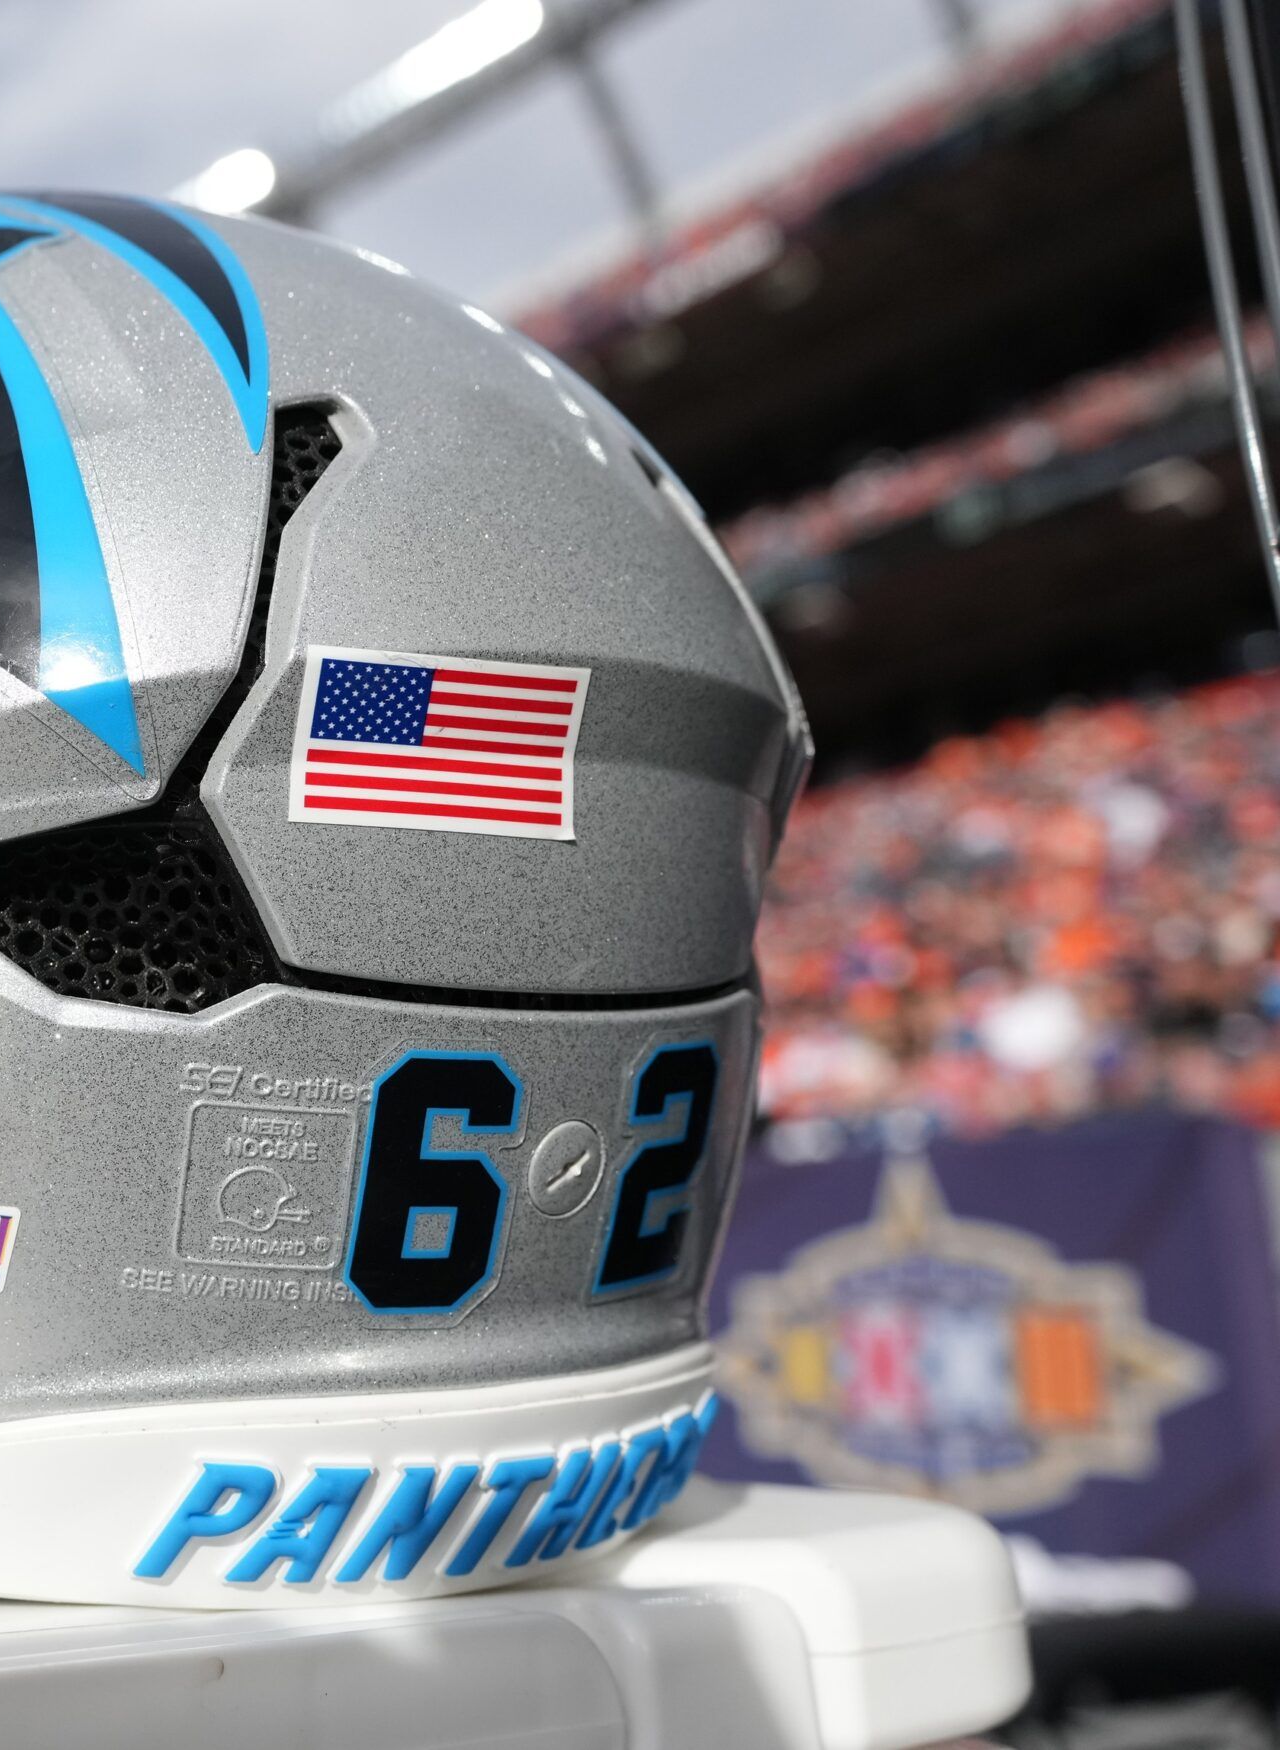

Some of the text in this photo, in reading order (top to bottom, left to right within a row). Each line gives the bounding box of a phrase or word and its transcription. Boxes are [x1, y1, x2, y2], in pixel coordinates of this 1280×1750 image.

[240, 1117, 307, 1138] MEETS
[224, 1136, 320, 1163] NOCSAE
[344, 1040, 720, 1314] 6 2
[210, 1236, 307, 1256] STANDARD
[121, 1267, 172, 1292] SEE
[181, 1273, 300, 1301] WARNING
